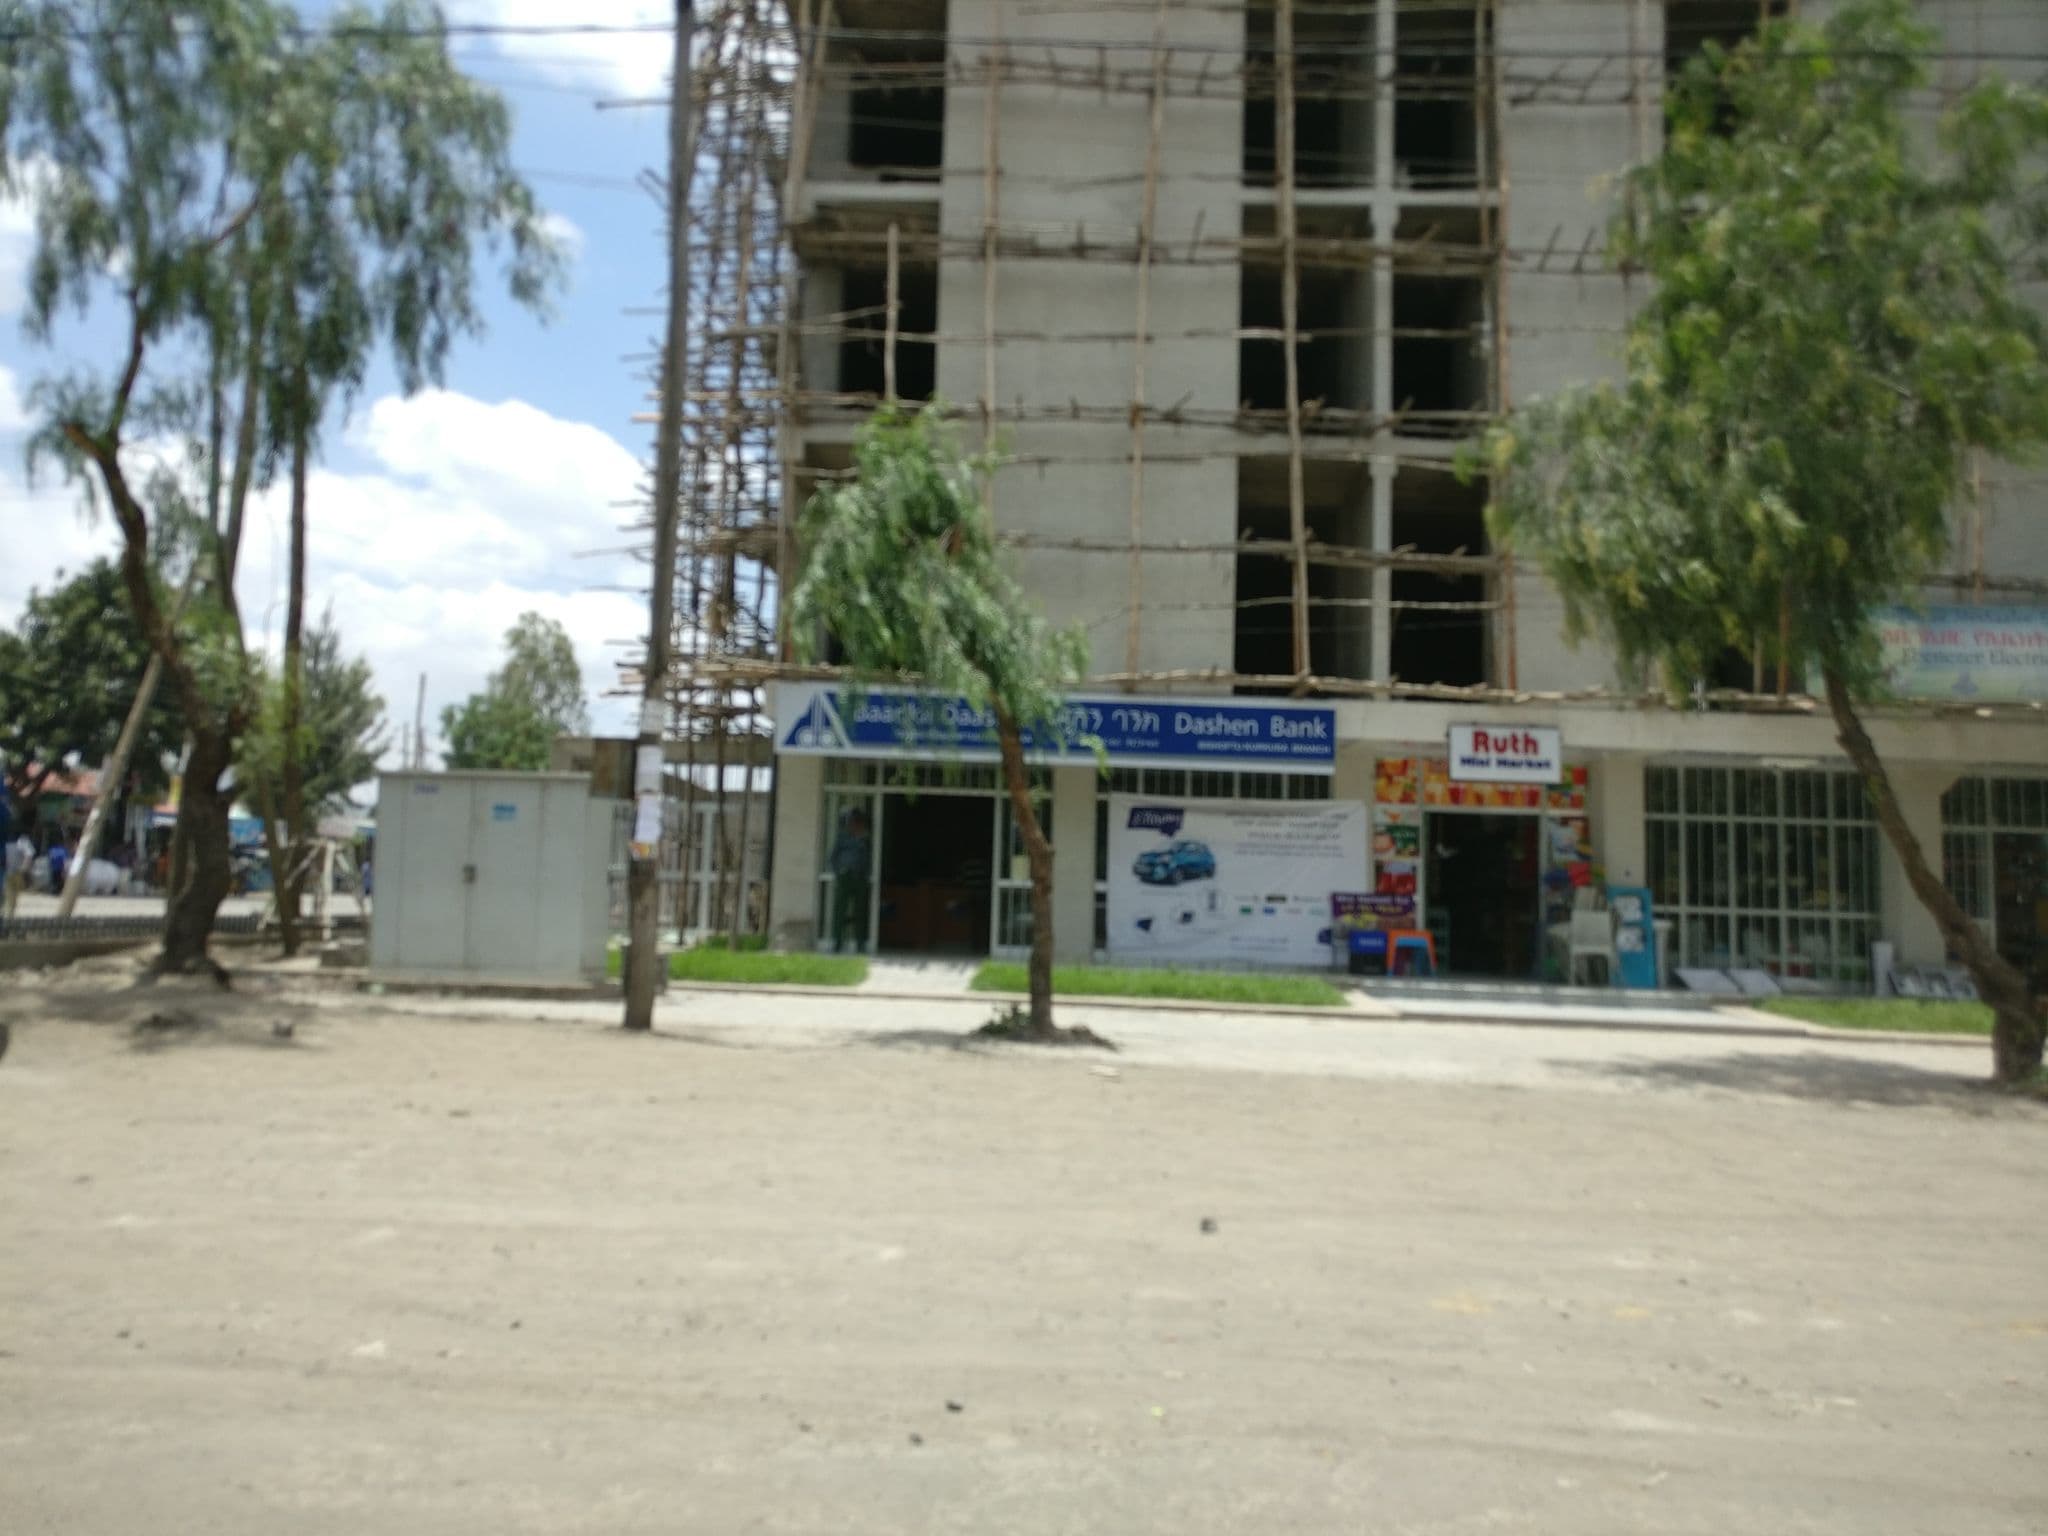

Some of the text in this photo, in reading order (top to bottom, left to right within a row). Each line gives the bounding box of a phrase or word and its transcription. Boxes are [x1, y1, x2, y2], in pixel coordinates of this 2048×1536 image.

[1174, 712, 1328, 739] Dashen Bank
[1472, 730, 1539, 755] Ruth
